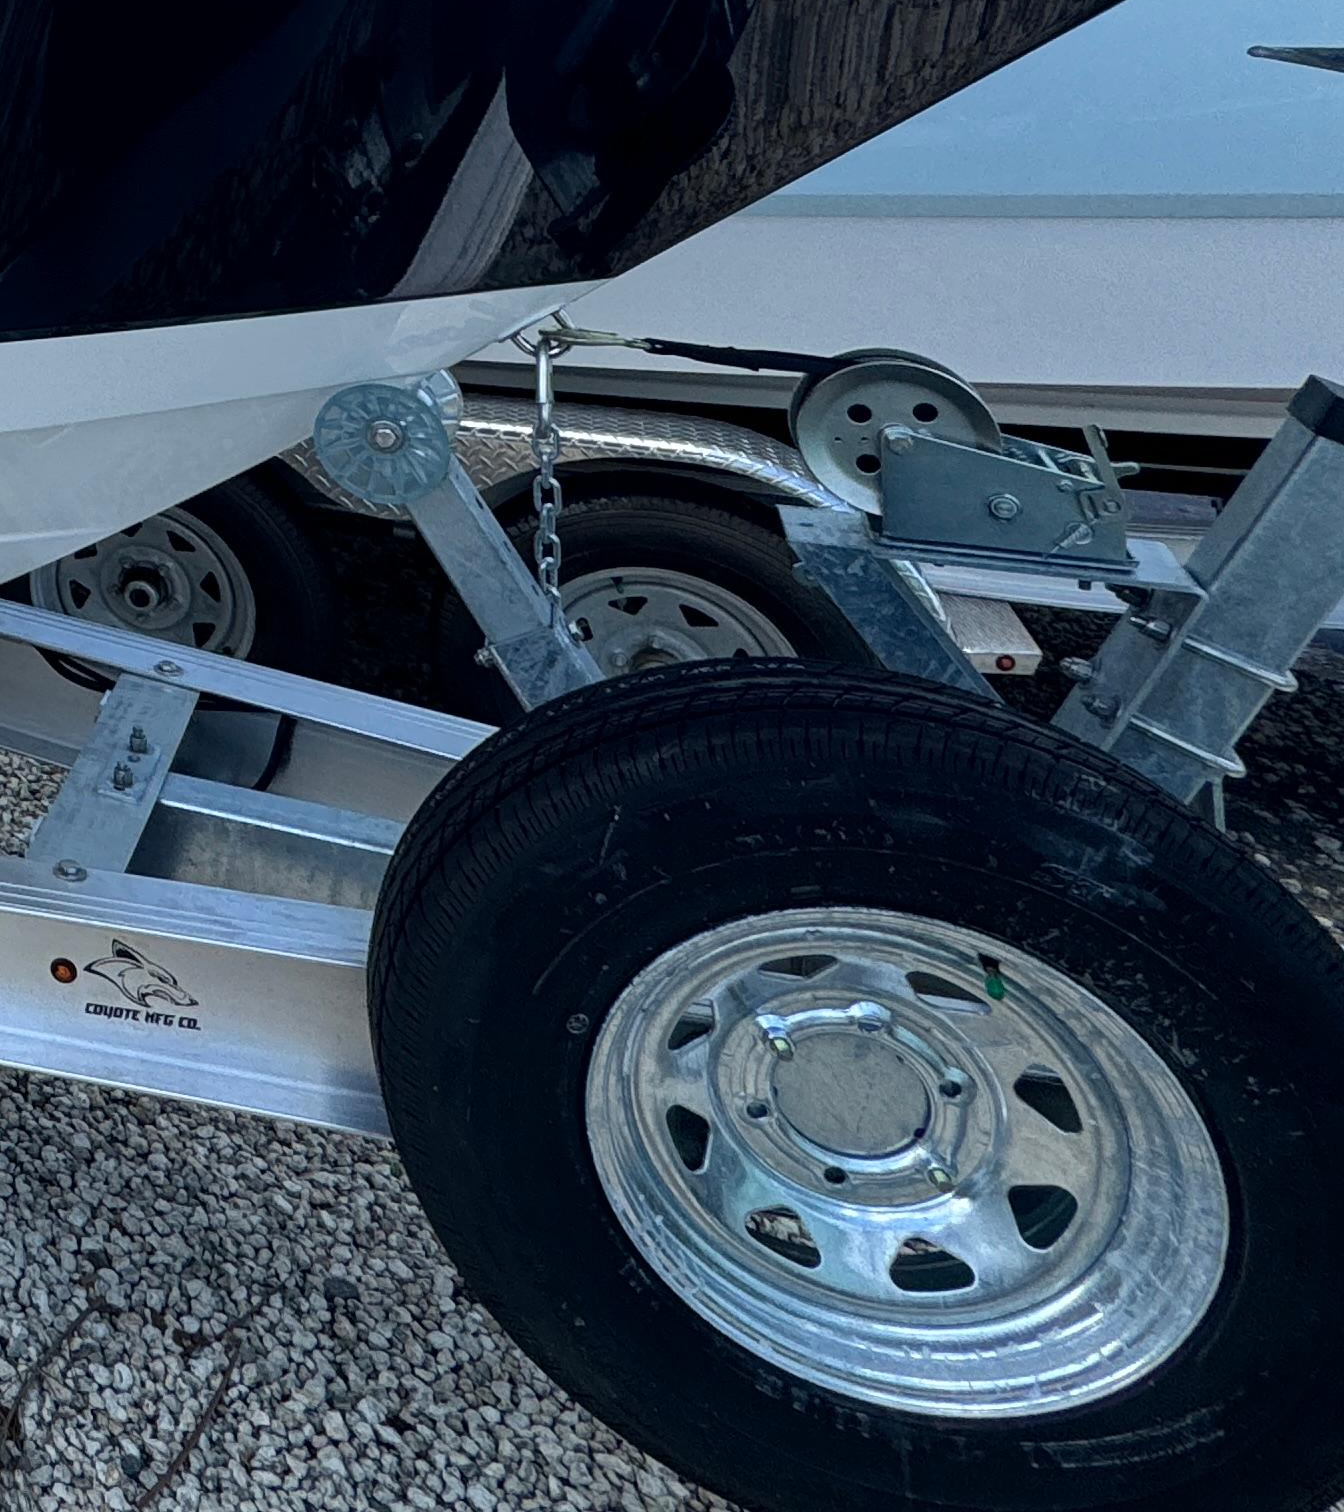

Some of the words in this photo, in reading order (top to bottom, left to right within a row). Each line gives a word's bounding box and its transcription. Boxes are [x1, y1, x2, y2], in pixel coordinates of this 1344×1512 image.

[84, 1002, 141, 1021] COYOTE
[144, 1010, 176, 1027] MFG
[178, 1016, 202, 1031] CO.
